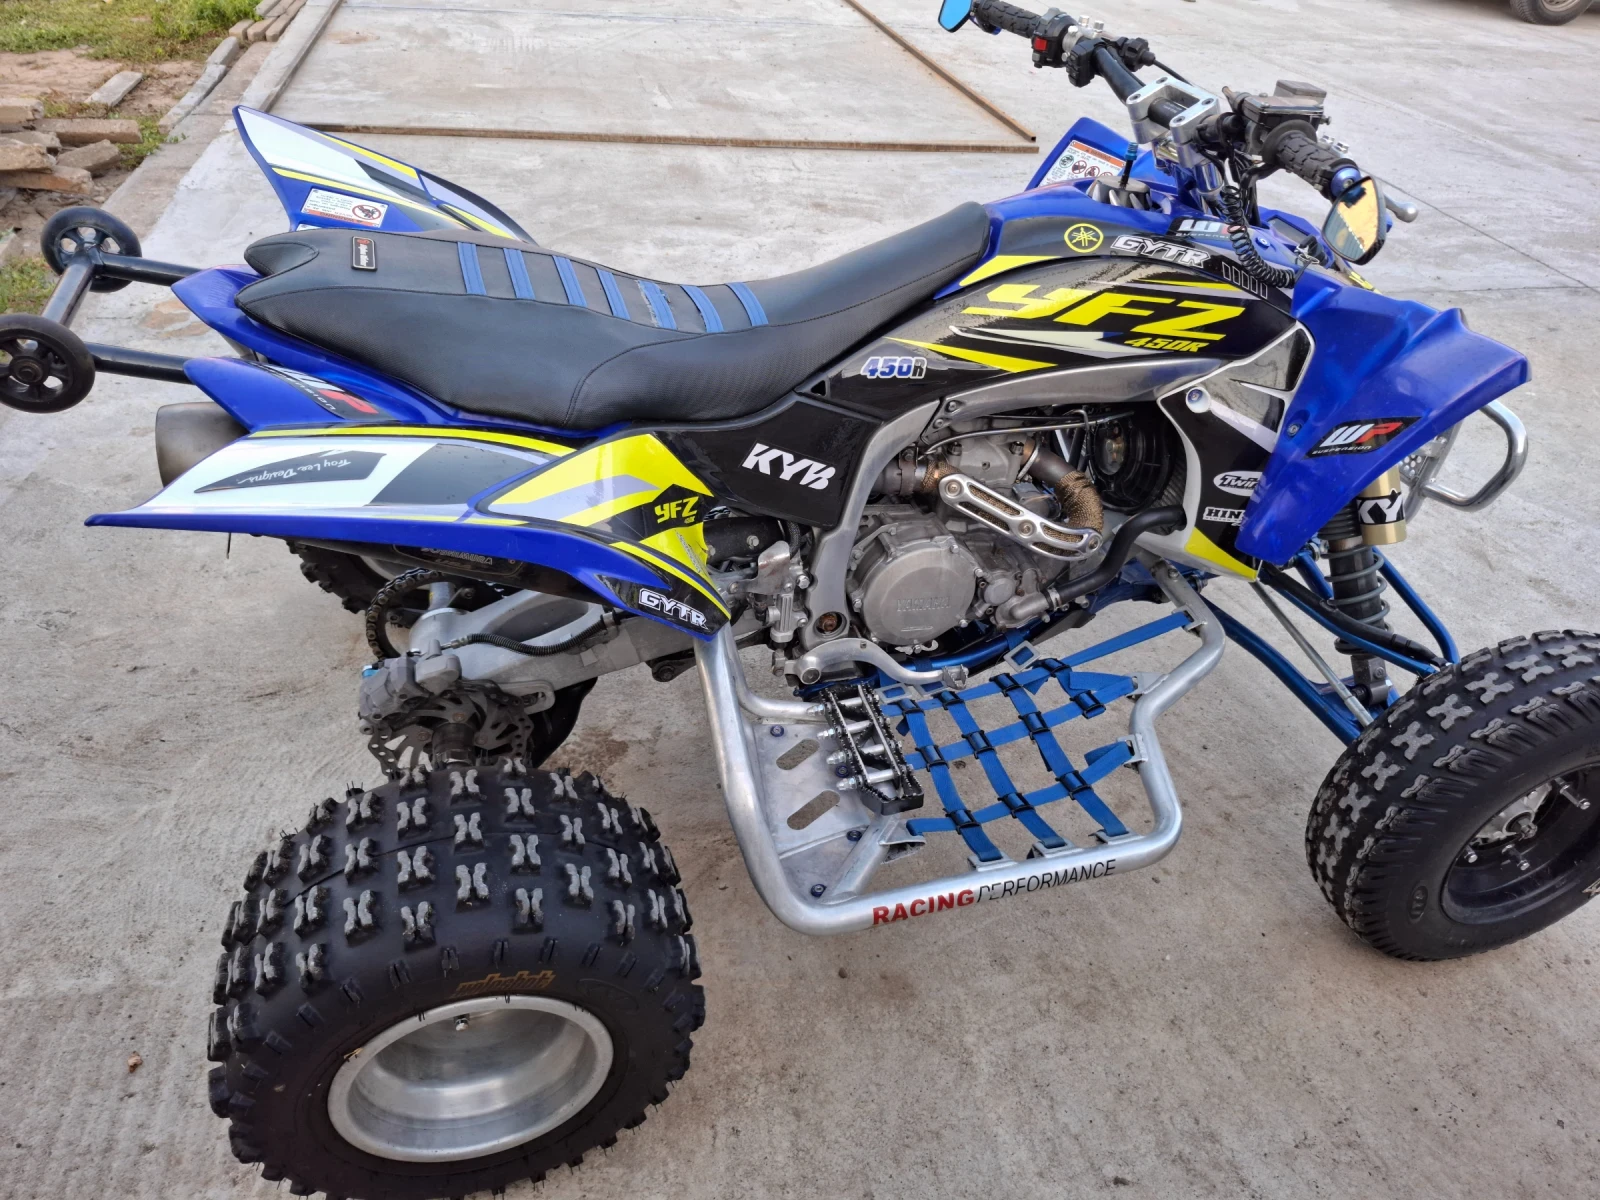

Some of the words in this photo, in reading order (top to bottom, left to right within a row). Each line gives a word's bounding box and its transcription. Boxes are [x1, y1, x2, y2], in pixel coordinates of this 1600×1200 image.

[1110, 234, 1211, 268] GYTR
[961, 284, 1246, 341] YFZ
[1123, 337, 1209, 353] 450R
[860, 356, 927, 379] 450R
[1319, 422, 1403, 448] WP
[237, 467, 298, 485] Designs
[297, 463, 321, 472] Lee
[323, 458, 352, 468] Troy
[741, 442, 836, 490] KYB
[654, 496, 699, 524] YFZ
[638, 588, 709, 630] GYTR
[872, 889, 975, 925] RACING
